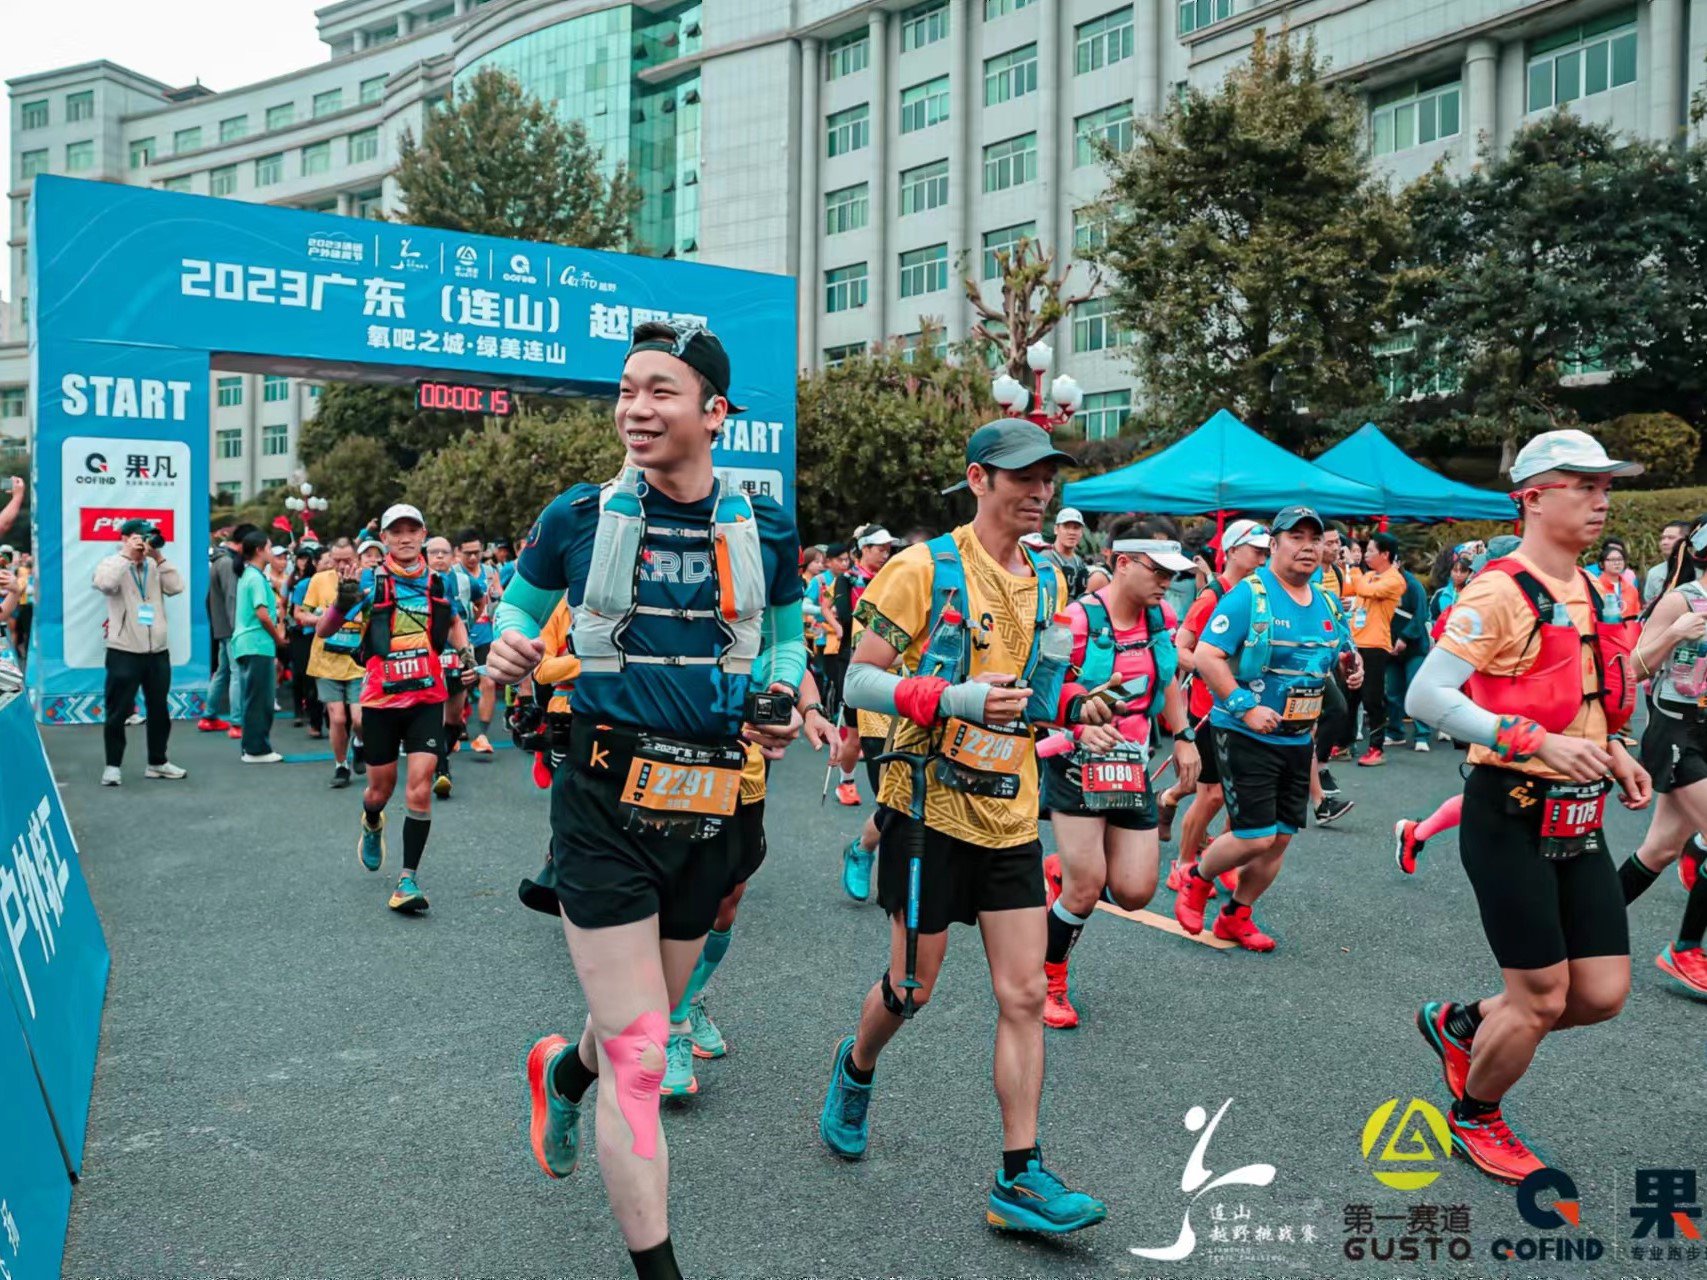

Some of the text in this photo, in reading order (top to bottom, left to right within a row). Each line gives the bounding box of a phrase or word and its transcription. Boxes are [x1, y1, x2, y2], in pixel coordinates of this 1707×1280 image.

[61, 374, 191, 421] START
[710, 418, 784, 454] TART
[125, 455, 177, 478] 果凡
[651, 766, 715, 798] 2291
